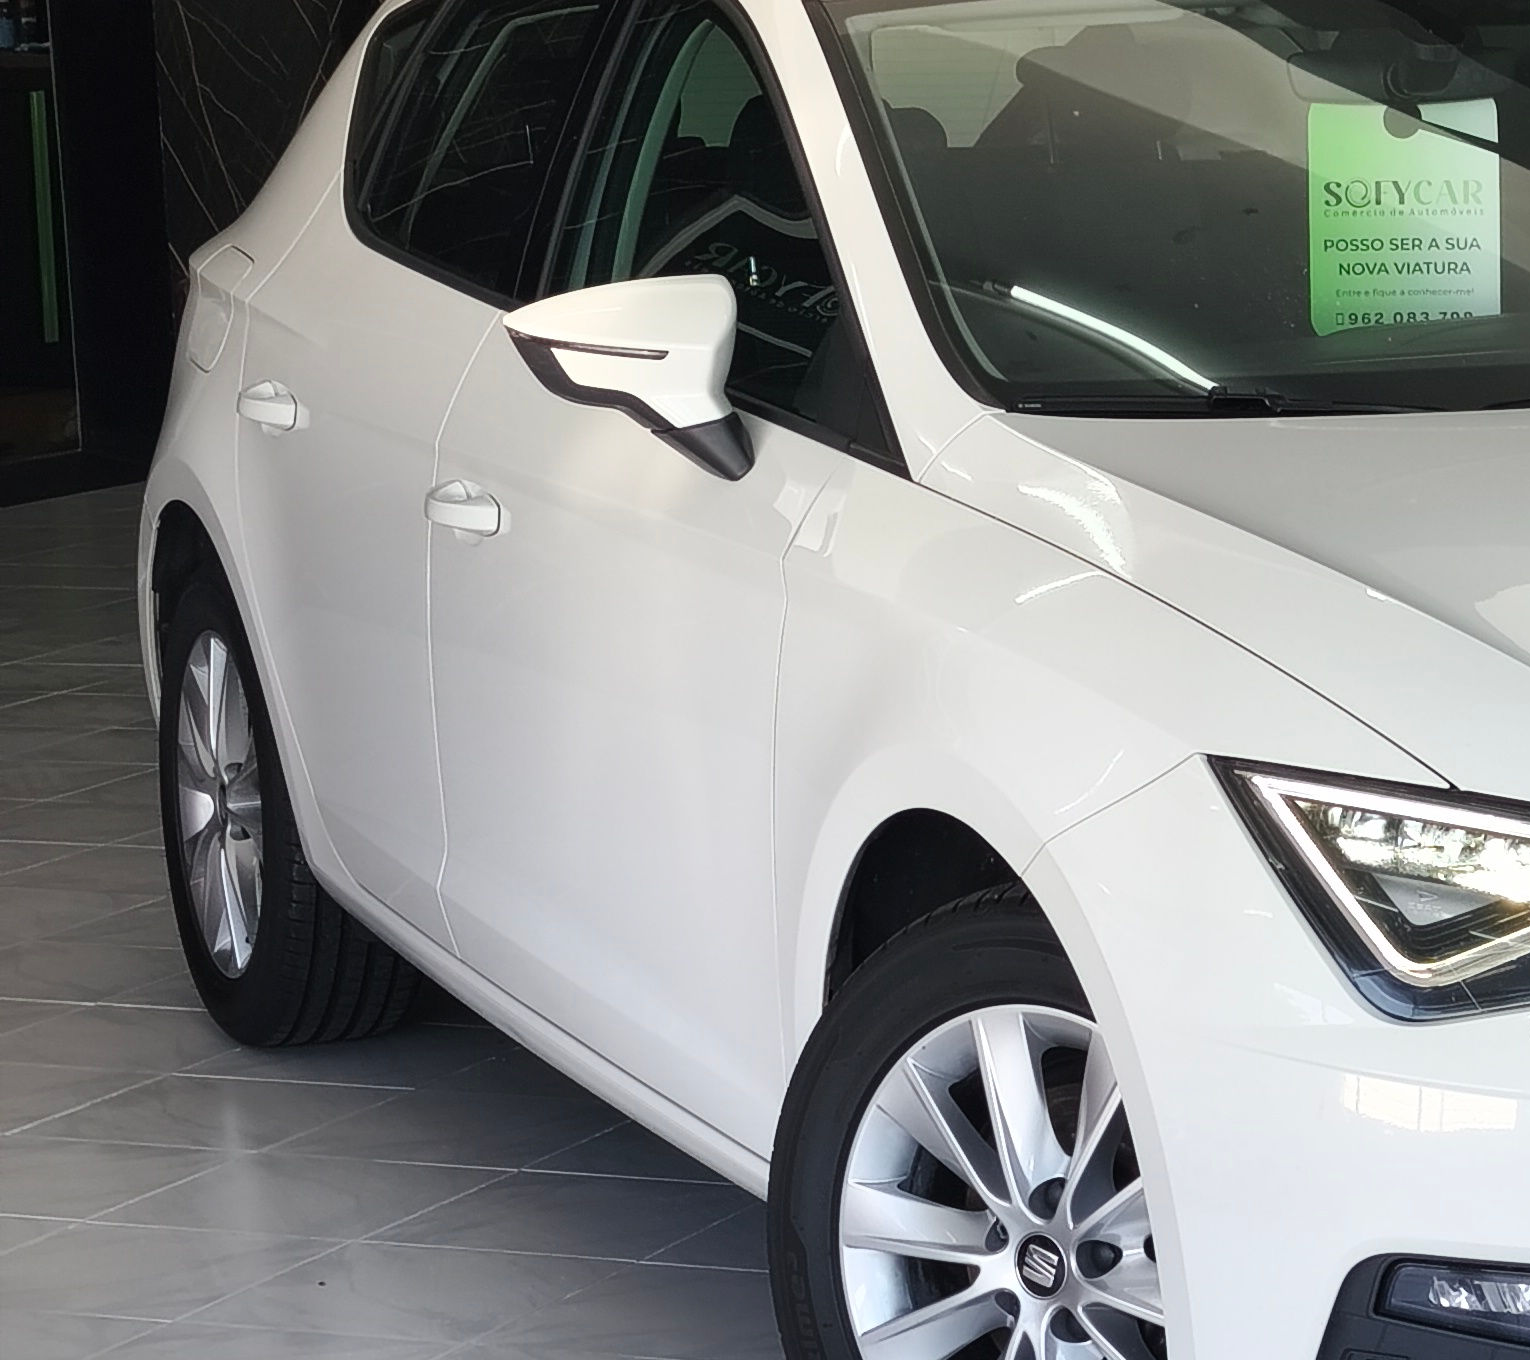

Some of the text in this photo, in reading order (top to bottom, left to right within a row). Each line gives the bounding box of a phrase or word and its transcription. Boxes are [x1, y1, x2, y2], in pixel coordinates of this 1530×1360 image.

[1323, 180, 1483, 208] SOFYCAR
[1323, 207, 1485, 217] Comércio de Automóveis
[1323, 237, 1482, 253] POSSO SER A SUA
[1338, 261, 1472, 276] NOVA VIATURA
[1348, 311, 1385, 326] 962
[1393, 311, 1430, 325] 083
